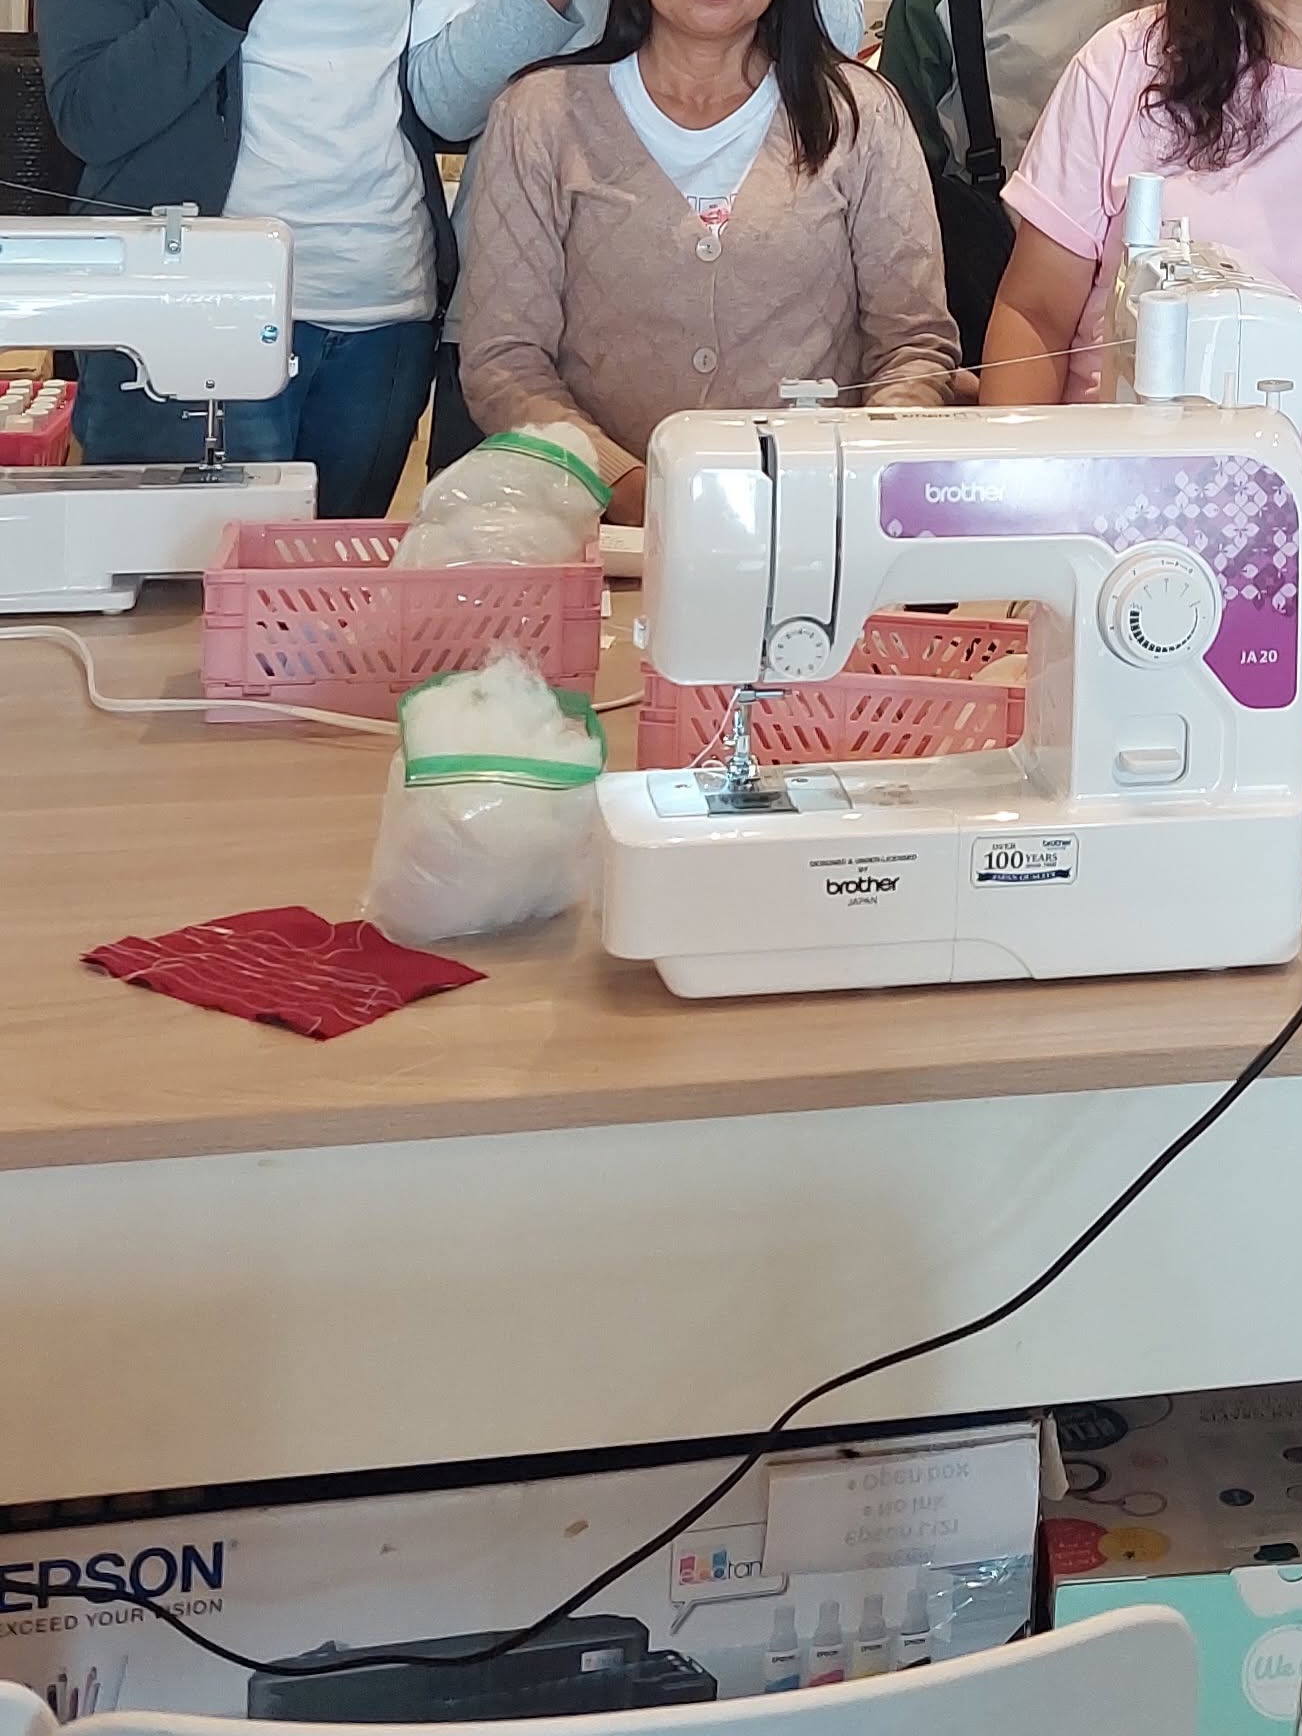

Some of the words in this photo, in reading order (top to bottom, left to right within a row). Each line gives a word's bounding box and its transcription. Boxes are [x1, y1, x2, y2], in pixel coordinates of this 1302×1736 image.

[925, 482, 1005, 503] brother
[984, 850, 1023, 871] 100
[1025, 853, 1058, 864] YEARS
[826, 875, 900, 896] brother
[848, 896, 878, 907] JAPAN
[0, 1540, 224, 1613] EPSON
[86, 1607, 144, 1628] YOUR
